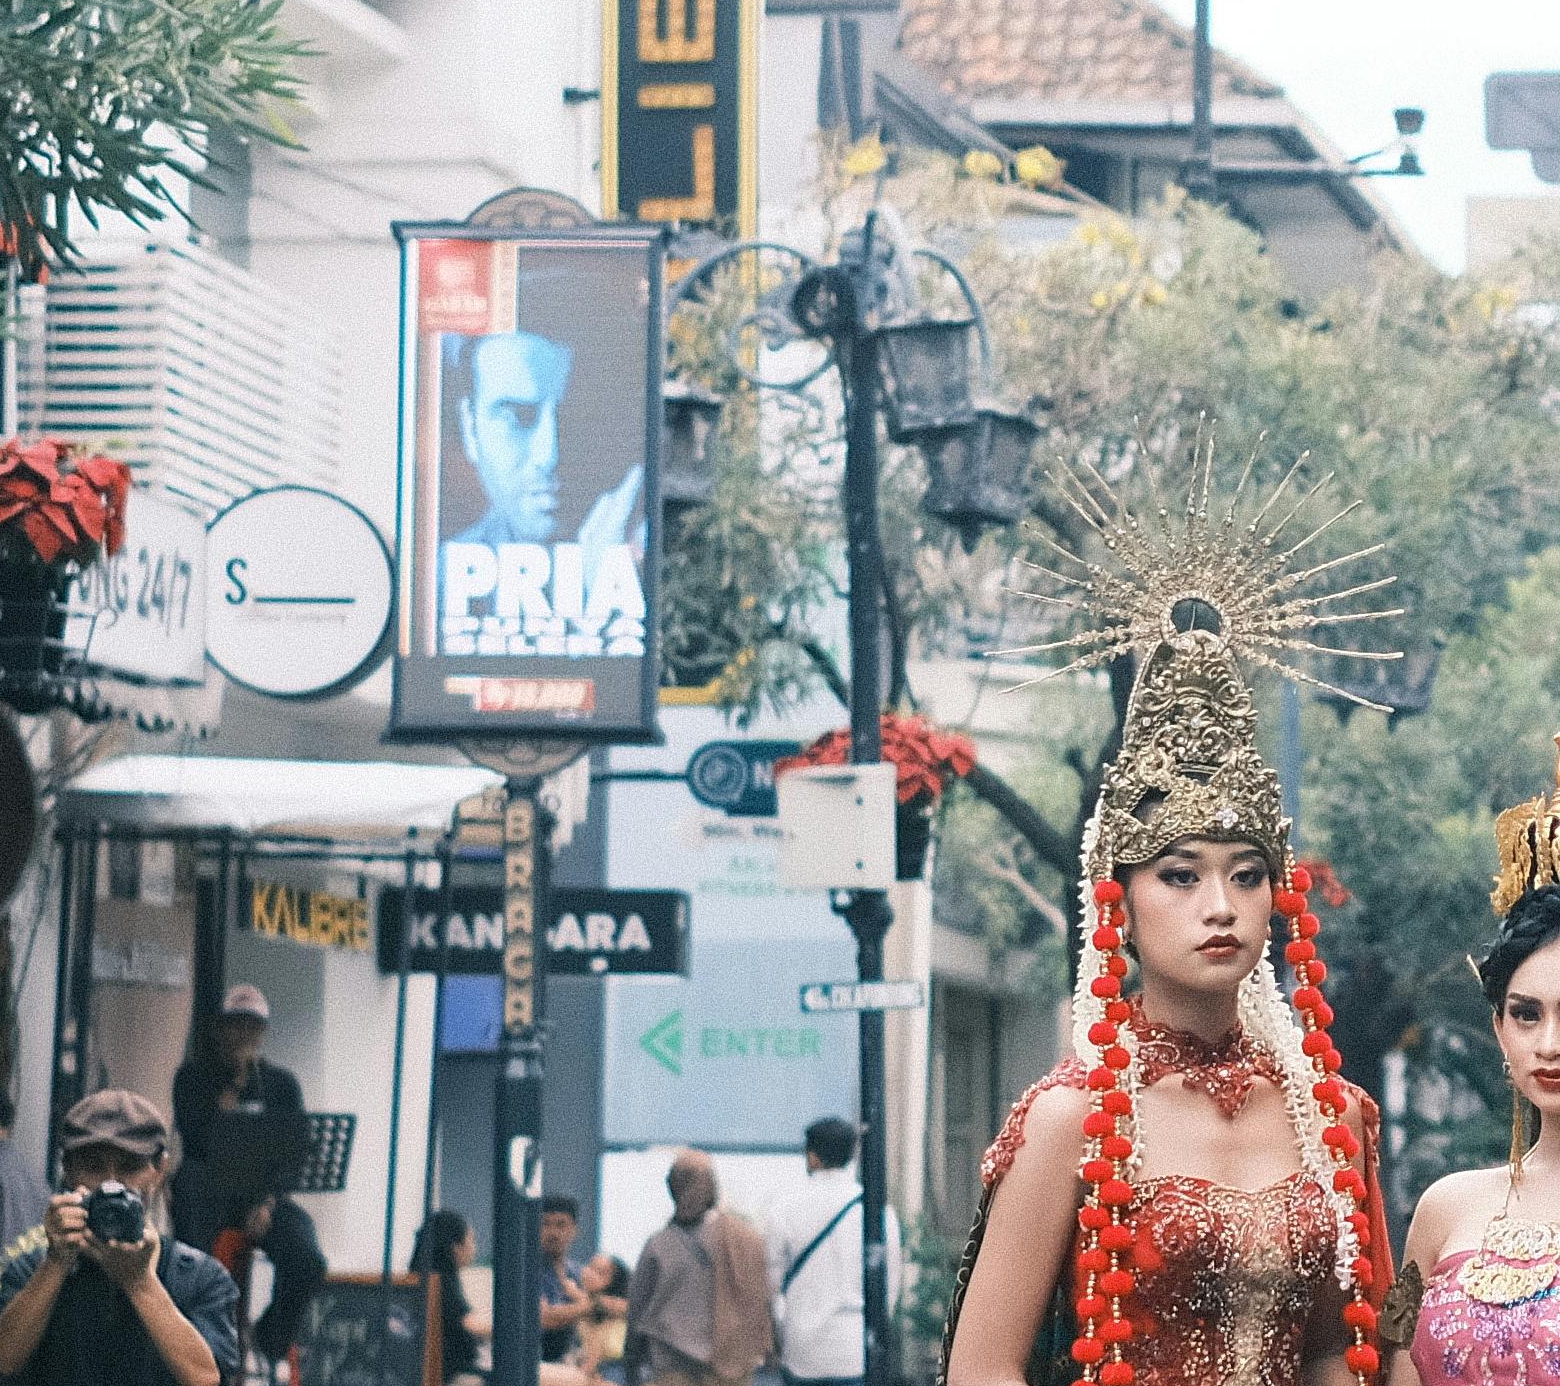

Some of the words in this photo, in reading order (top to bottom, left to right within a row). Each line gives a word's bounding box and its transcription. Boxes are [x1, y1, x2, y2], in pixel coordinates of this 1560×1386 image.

[136, 547, 193, 636] 24/7
[444, 542, 647, 617] PRIA
[252, 881, 371, 953] KALIBRE
[409, 912, 652, 952] KANARA
[504, 798, 535, 1036] BRAGA
[700, 1028, 823, 1058] ENTER
